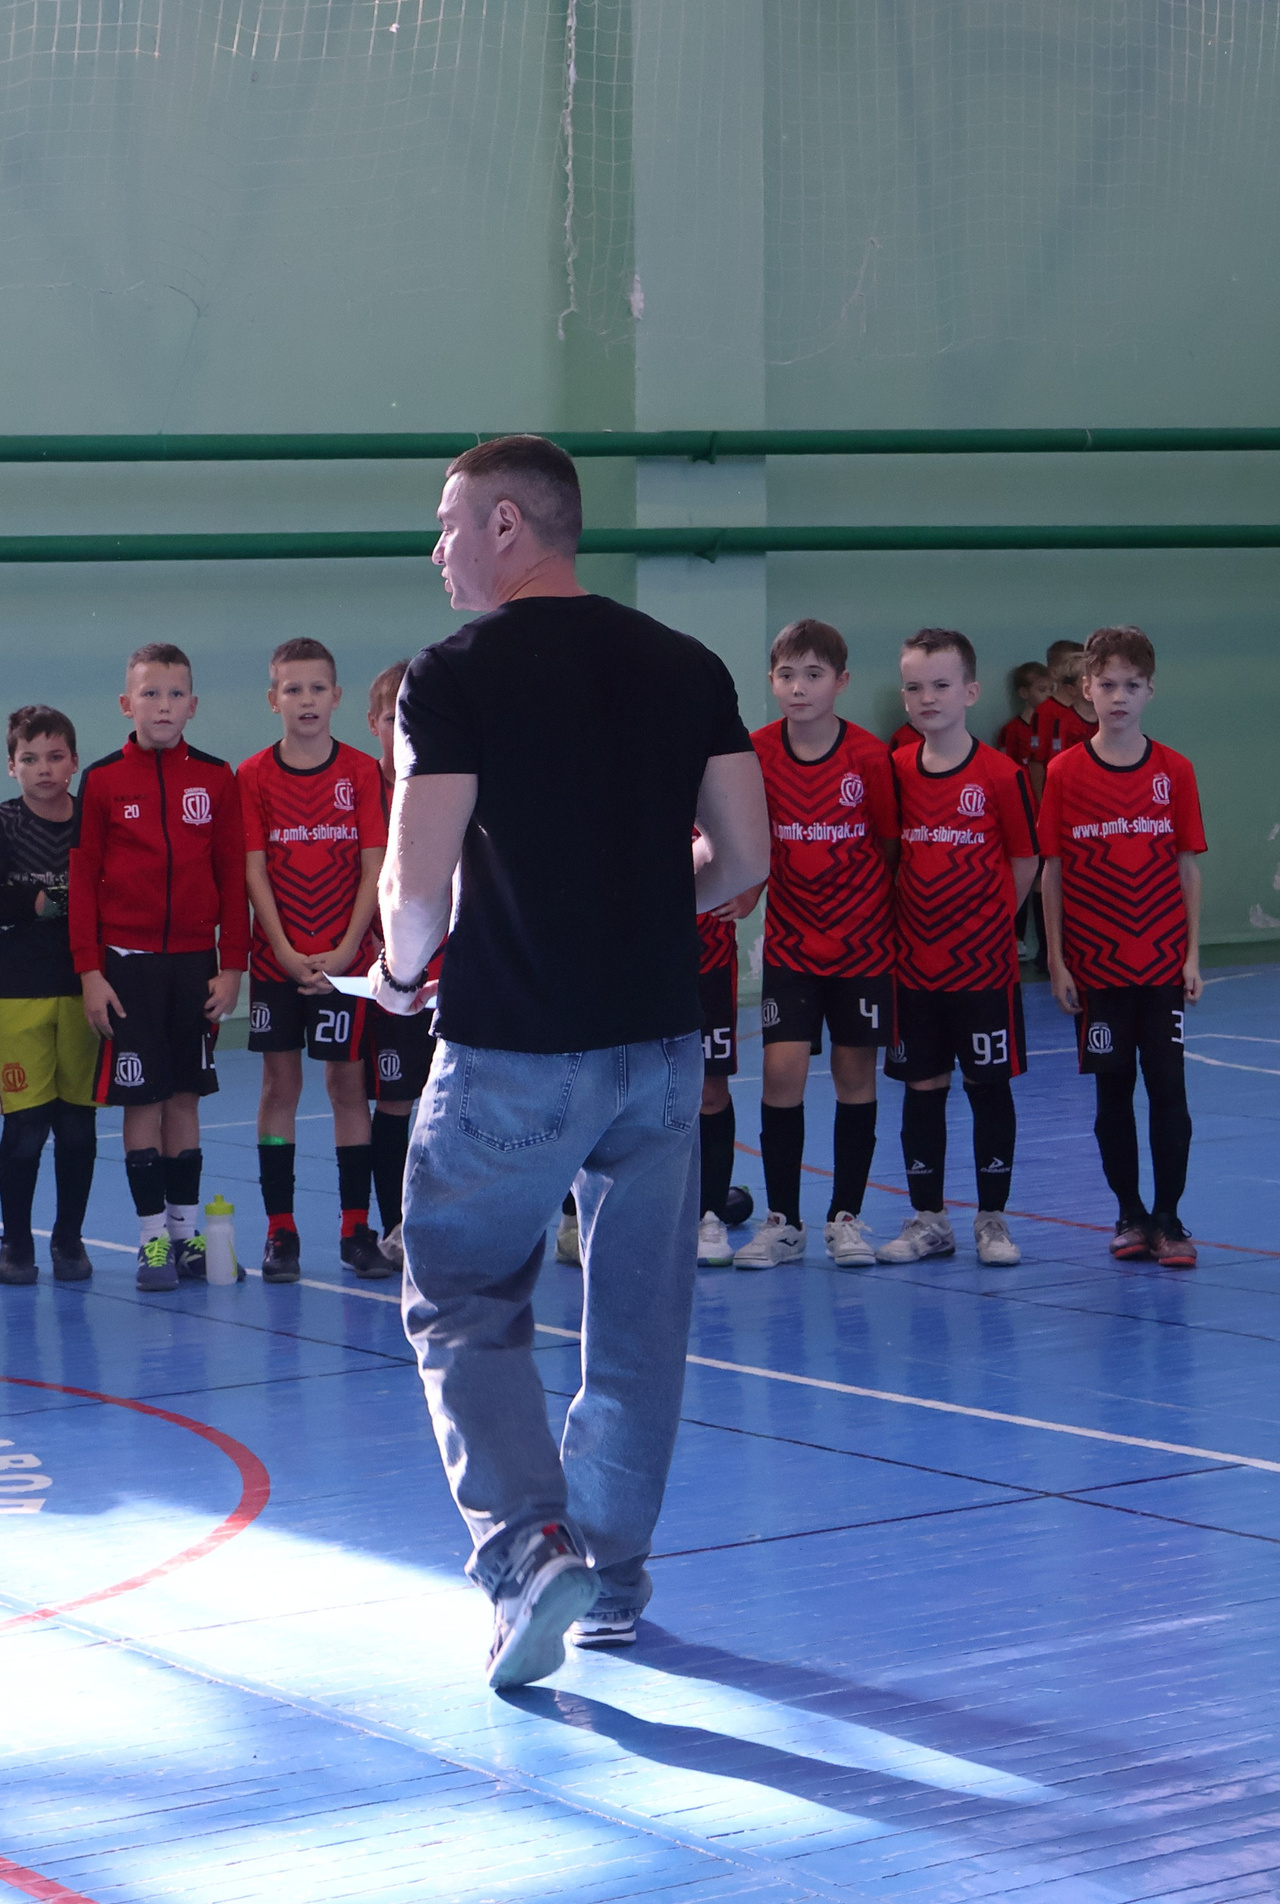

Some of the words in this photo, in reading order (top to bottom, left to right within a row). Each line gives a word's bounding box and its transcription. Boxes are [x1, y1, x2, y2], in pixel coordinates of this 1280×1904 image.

[123, 804, 140, 819] 20
[315, 1009, 351, 1043] 20
[859, 998, 879, 1029] 4
[972, 1029, 1008, 1066] 93
